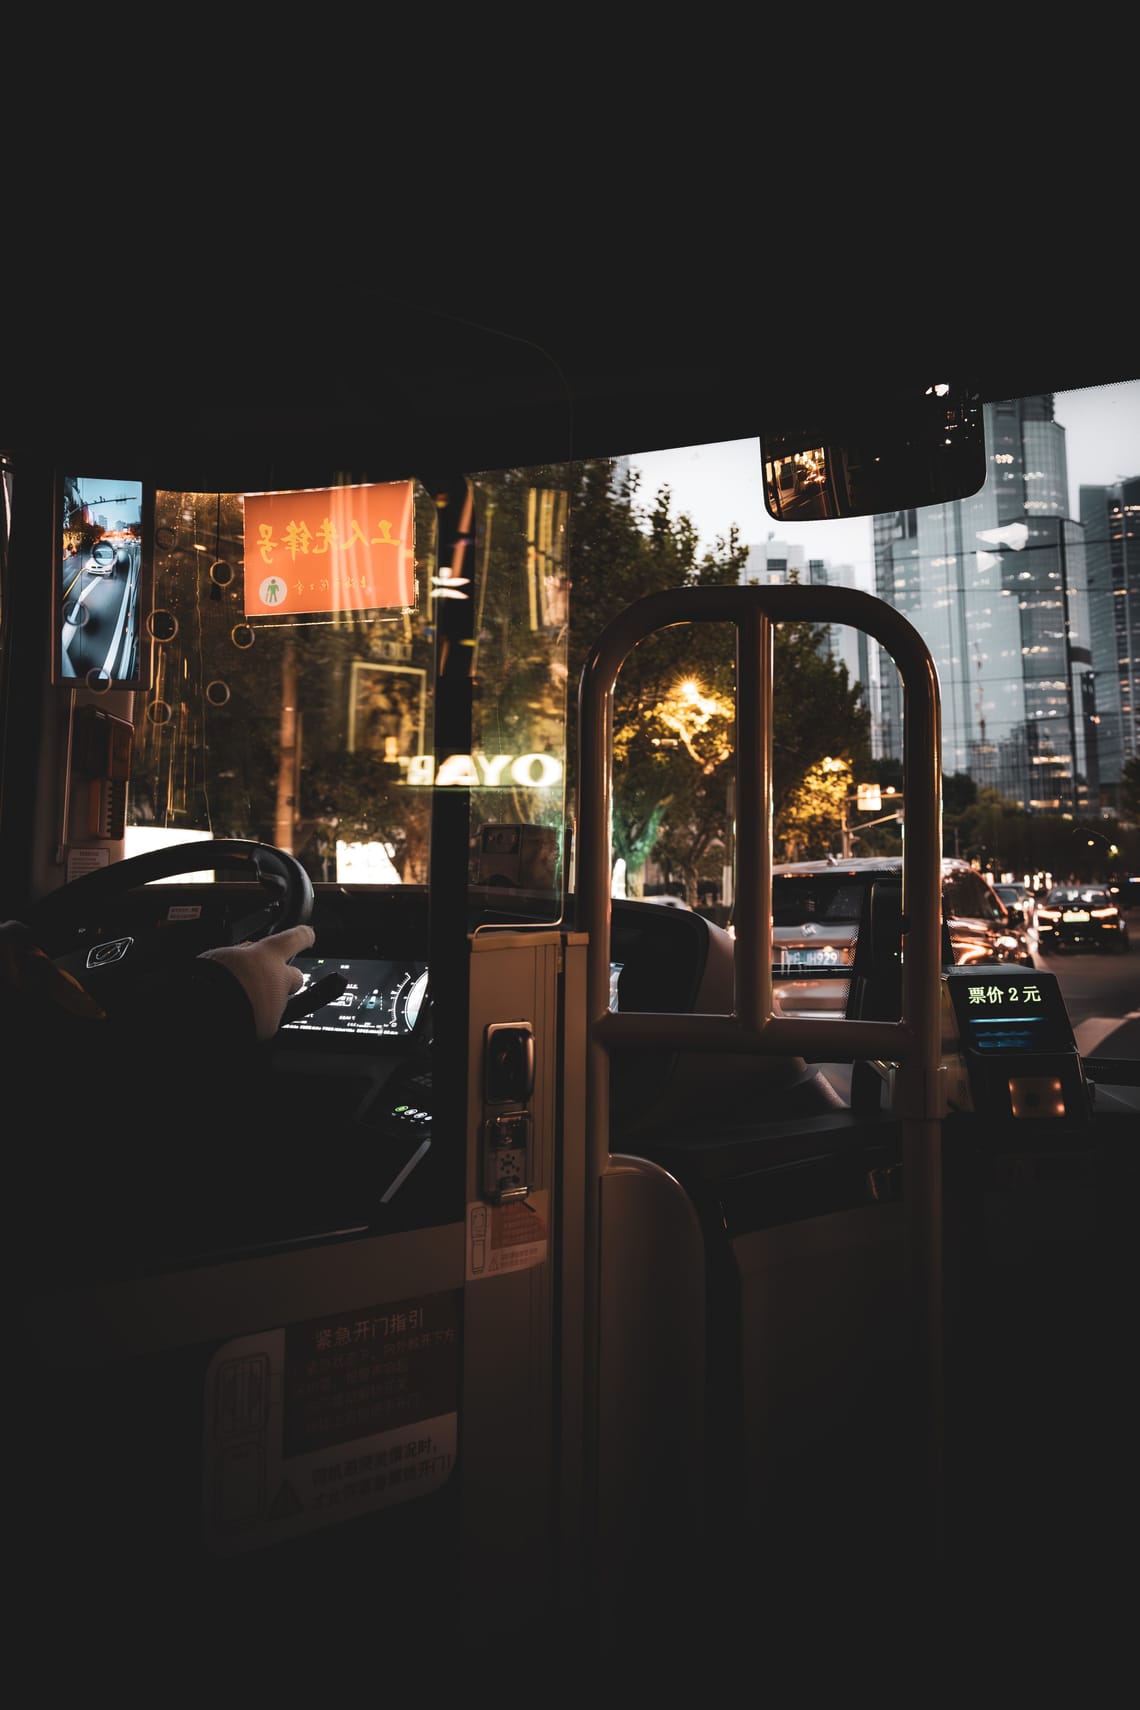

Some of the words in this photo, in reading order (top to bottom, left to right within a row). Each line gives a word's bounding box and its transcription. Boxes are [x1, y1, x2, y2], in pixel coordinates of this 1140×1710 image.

[312, 1307, 425, 1352] 紧急开门指引
